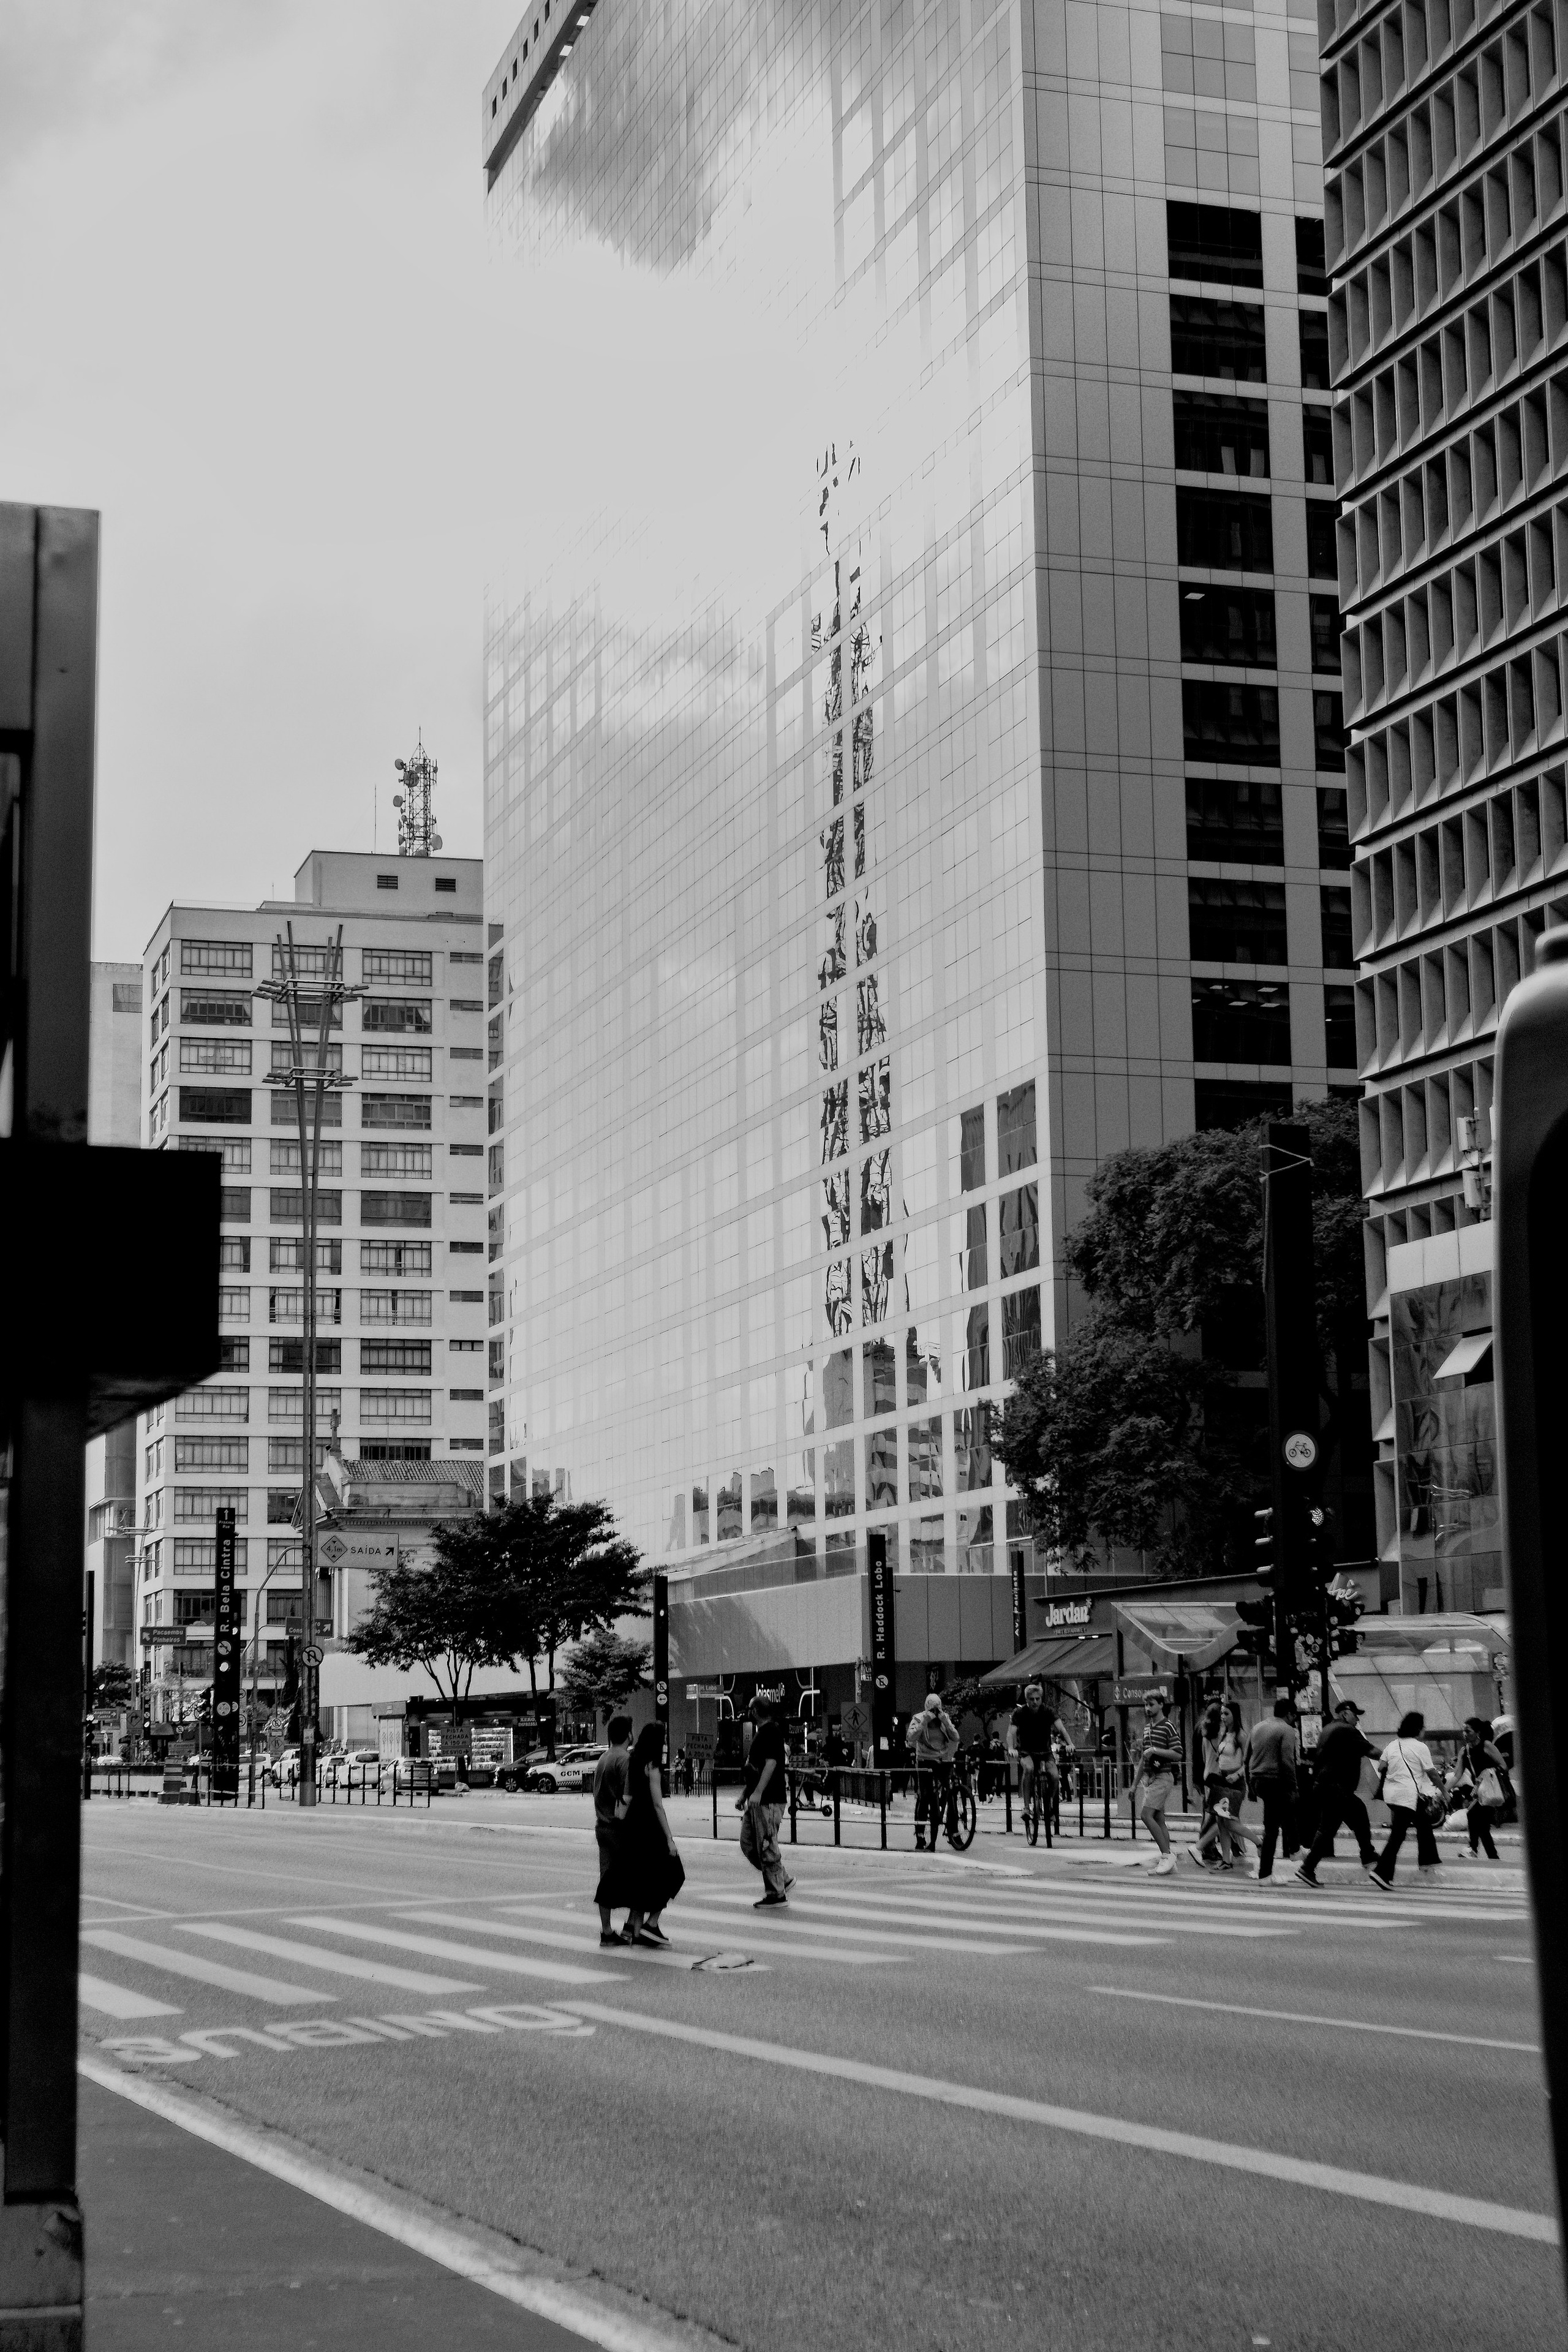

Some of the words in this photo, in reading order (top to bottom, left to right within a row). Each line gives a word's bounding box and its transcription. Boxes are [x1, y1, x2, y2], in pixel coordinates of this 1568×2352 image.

[221, 1539, 231, 1579] Cintra
[350, 1545, 381, 1555] SAÍDA
[874, 1561, 883, 1588] Lobo
[220, 1585, 230, 1613] Bela
[220, 1619, 229, 1632] R.
[875, 1594, 884, 1642] Haddock
[876, 1647, 885, 1659] R.
